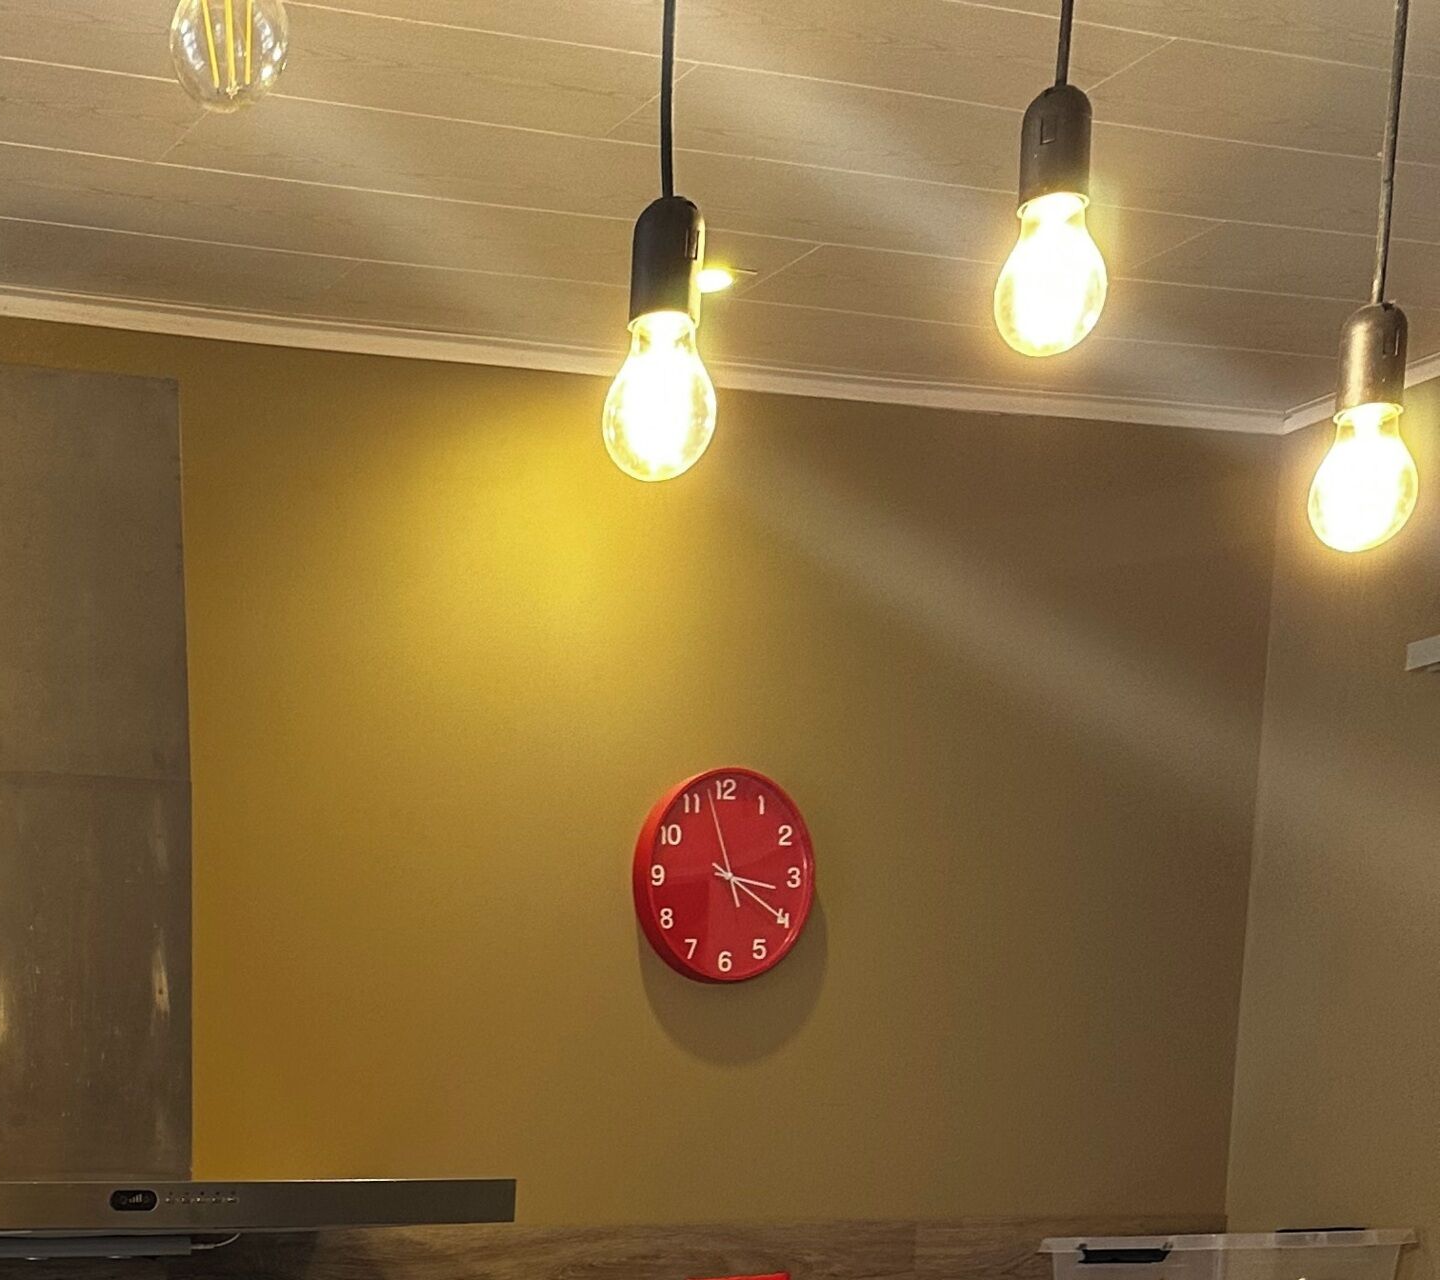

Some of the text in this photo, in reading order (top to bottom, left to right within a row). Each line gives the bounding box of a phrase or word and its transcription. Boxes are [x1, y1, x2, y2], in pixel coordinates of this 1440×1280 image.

[715, 779, 737, 800] 12
[683, 793, 701, 814] 11
[758, 795, 766, 815] 1
[660, 824, 682, 846] 10
[778, 825, 793, 846] 2
[651, 864, 665, 886] 9
[786, 867, 801, 888] 3
[660, 908, 674, 929] 8
[776, 908, 790, 929] 4
[684, 938, 698, 960] 7
[752, 938, 767, 960] 5
[717, 951, 732, 972] 6
